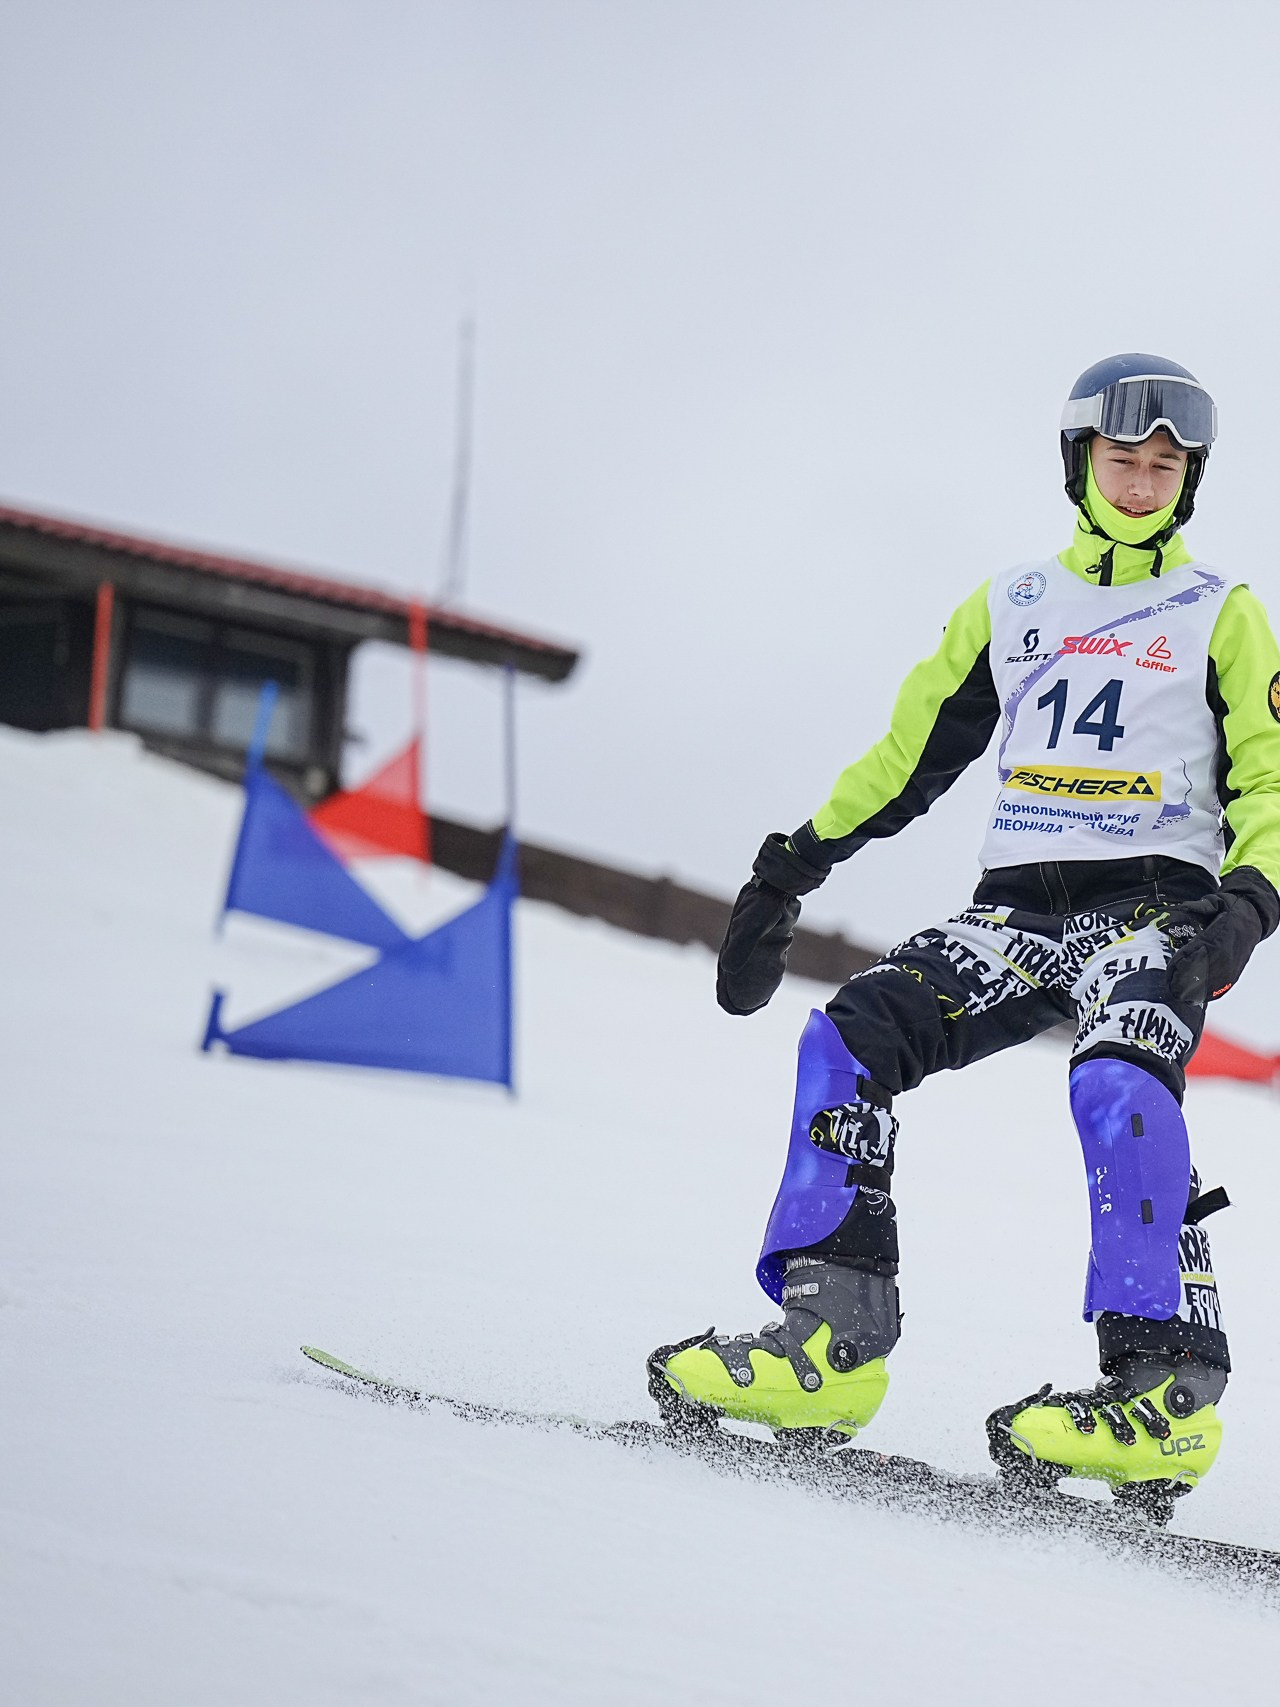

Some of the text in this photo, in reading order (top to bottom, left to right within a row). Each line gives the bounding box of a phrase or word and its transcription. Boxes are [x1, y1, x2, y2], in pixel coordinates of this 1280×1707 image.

[1005, 653, 1052, 664] SCOTT
[1037, 678, 1125, 752] 14
[1008, 771, 1129, 795] FISCHER
[998, 799, 1103, 822] Горнолыжный
[992, 818, 1064, 834] ЛЕОНИДА
